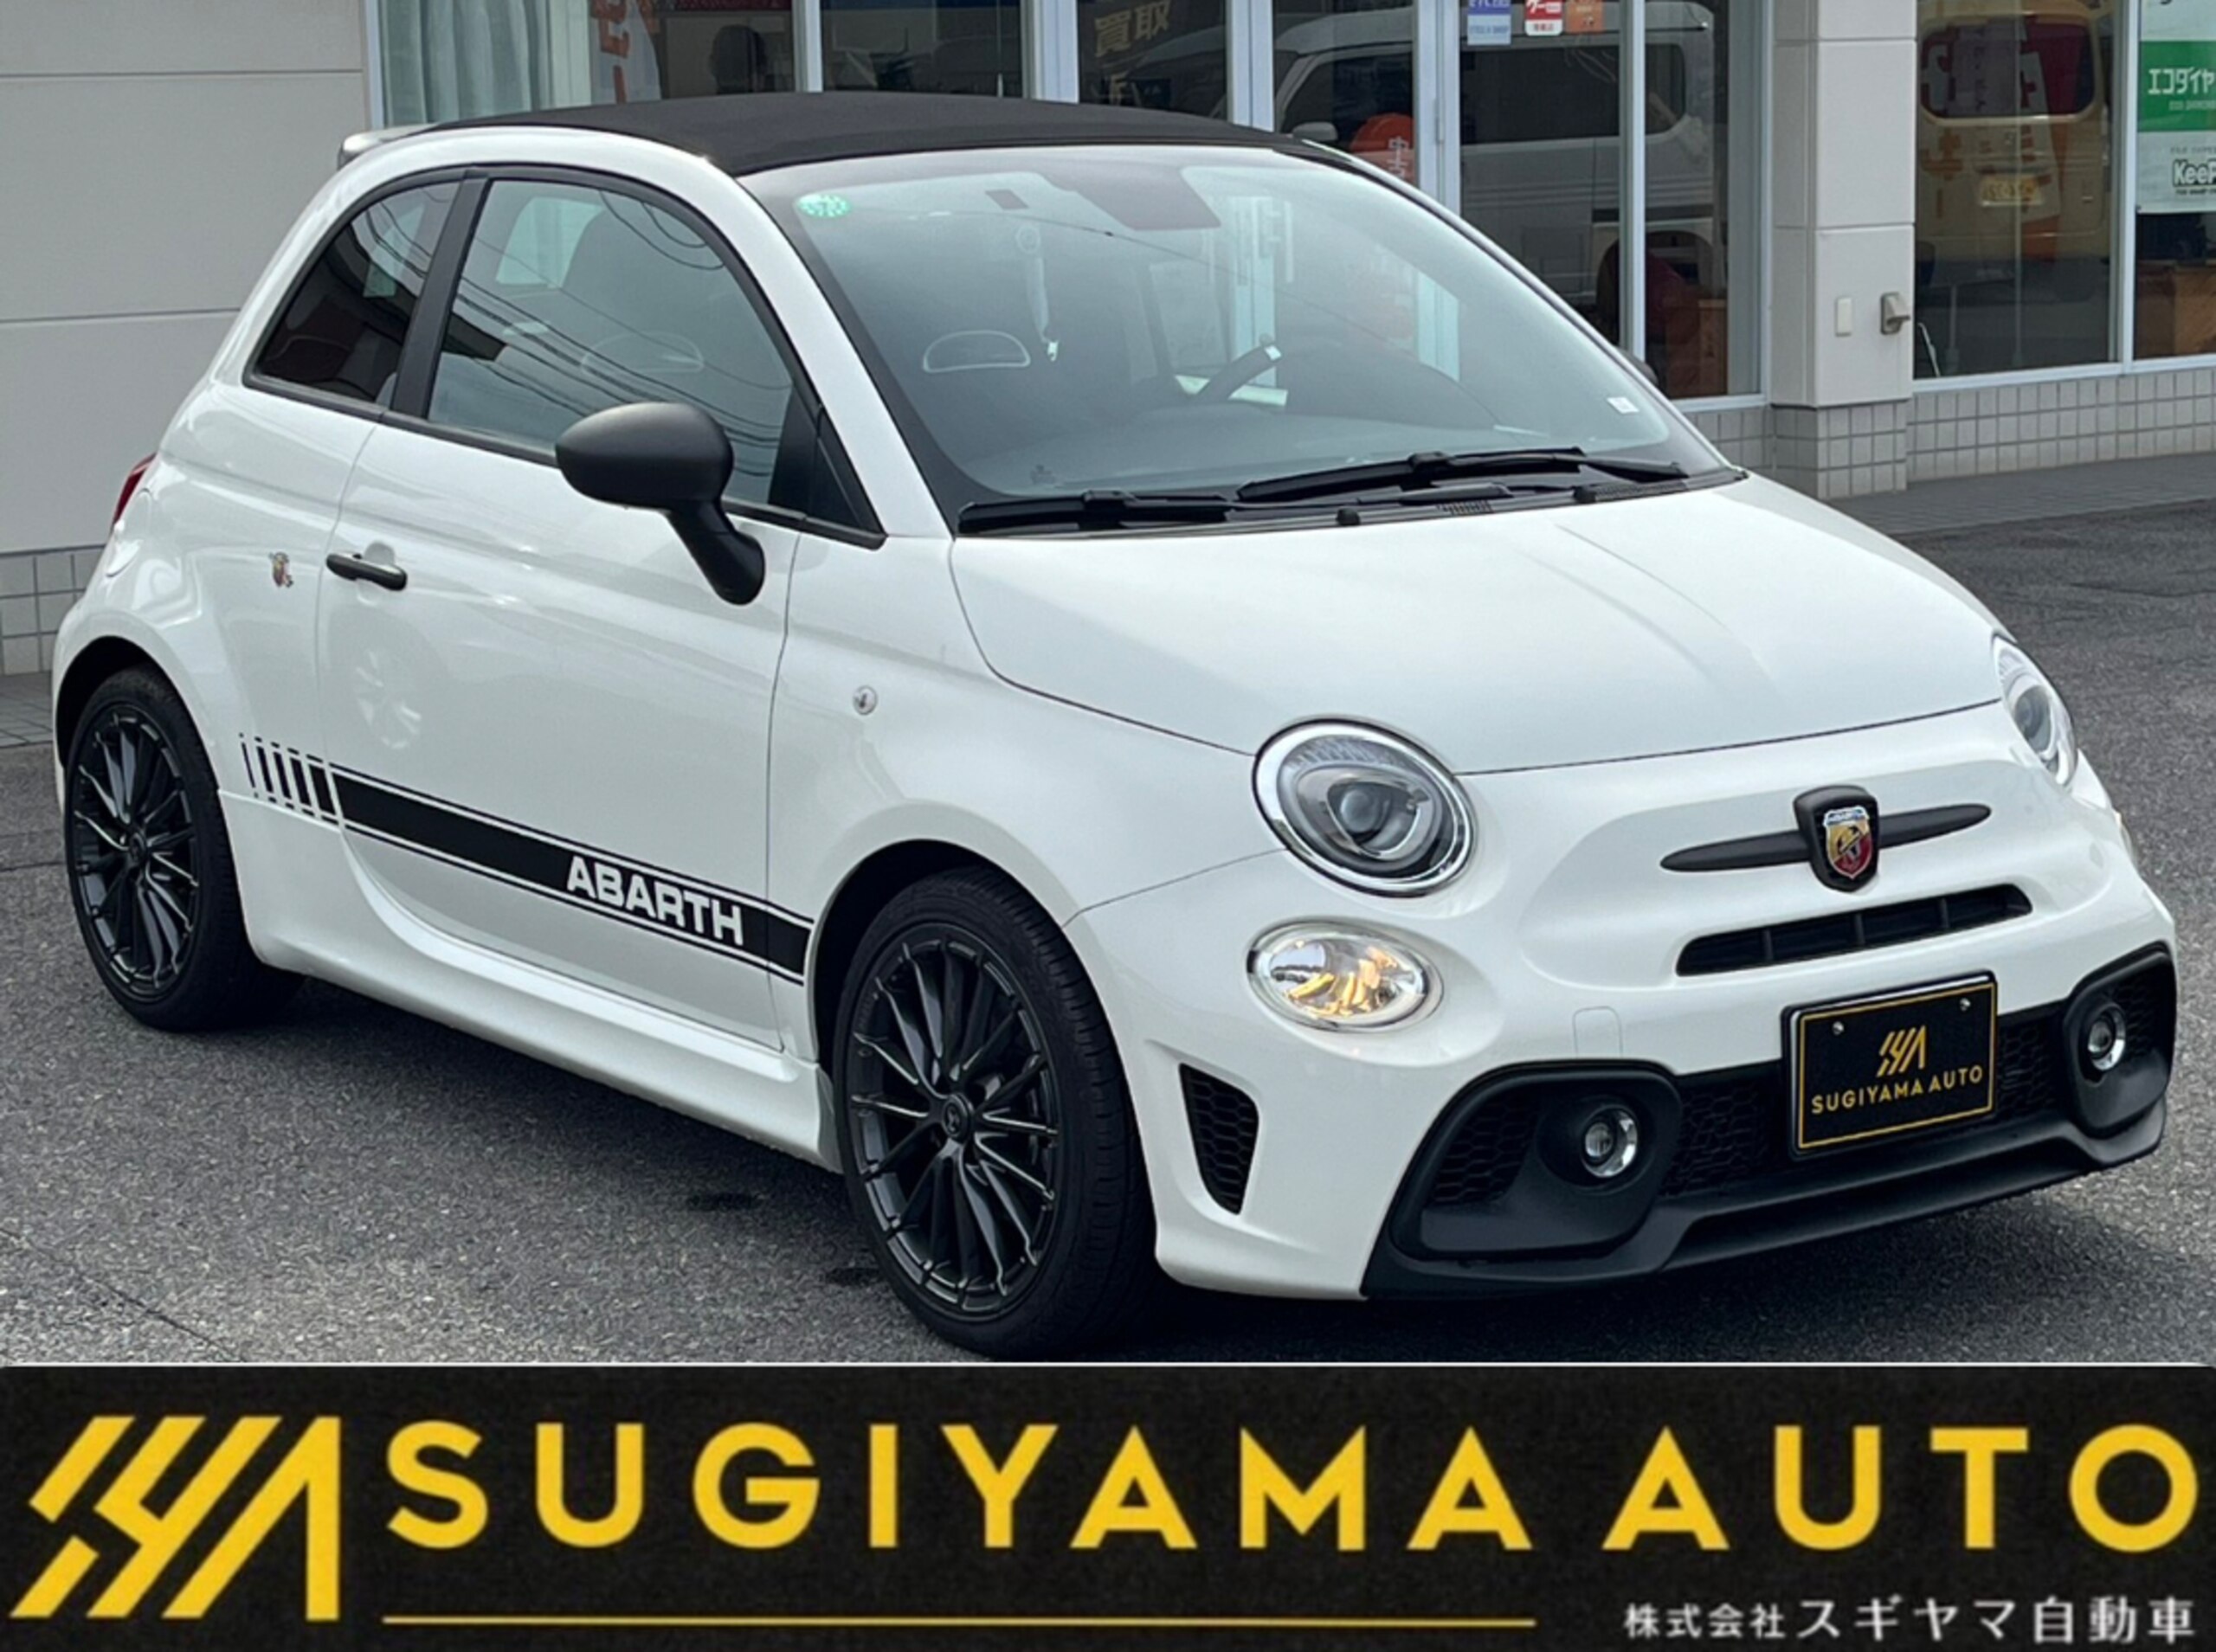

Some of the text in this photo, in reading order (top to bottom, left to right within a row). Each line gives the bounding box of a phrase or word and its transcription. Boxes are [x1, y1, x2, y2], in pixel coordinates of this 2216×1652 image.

[1094, 2, 1169, 57] 買取
[567, 856, 743, 945] ABARTH
[1811, 1064, 1983, 1114] SUGIYAMA AUTO
